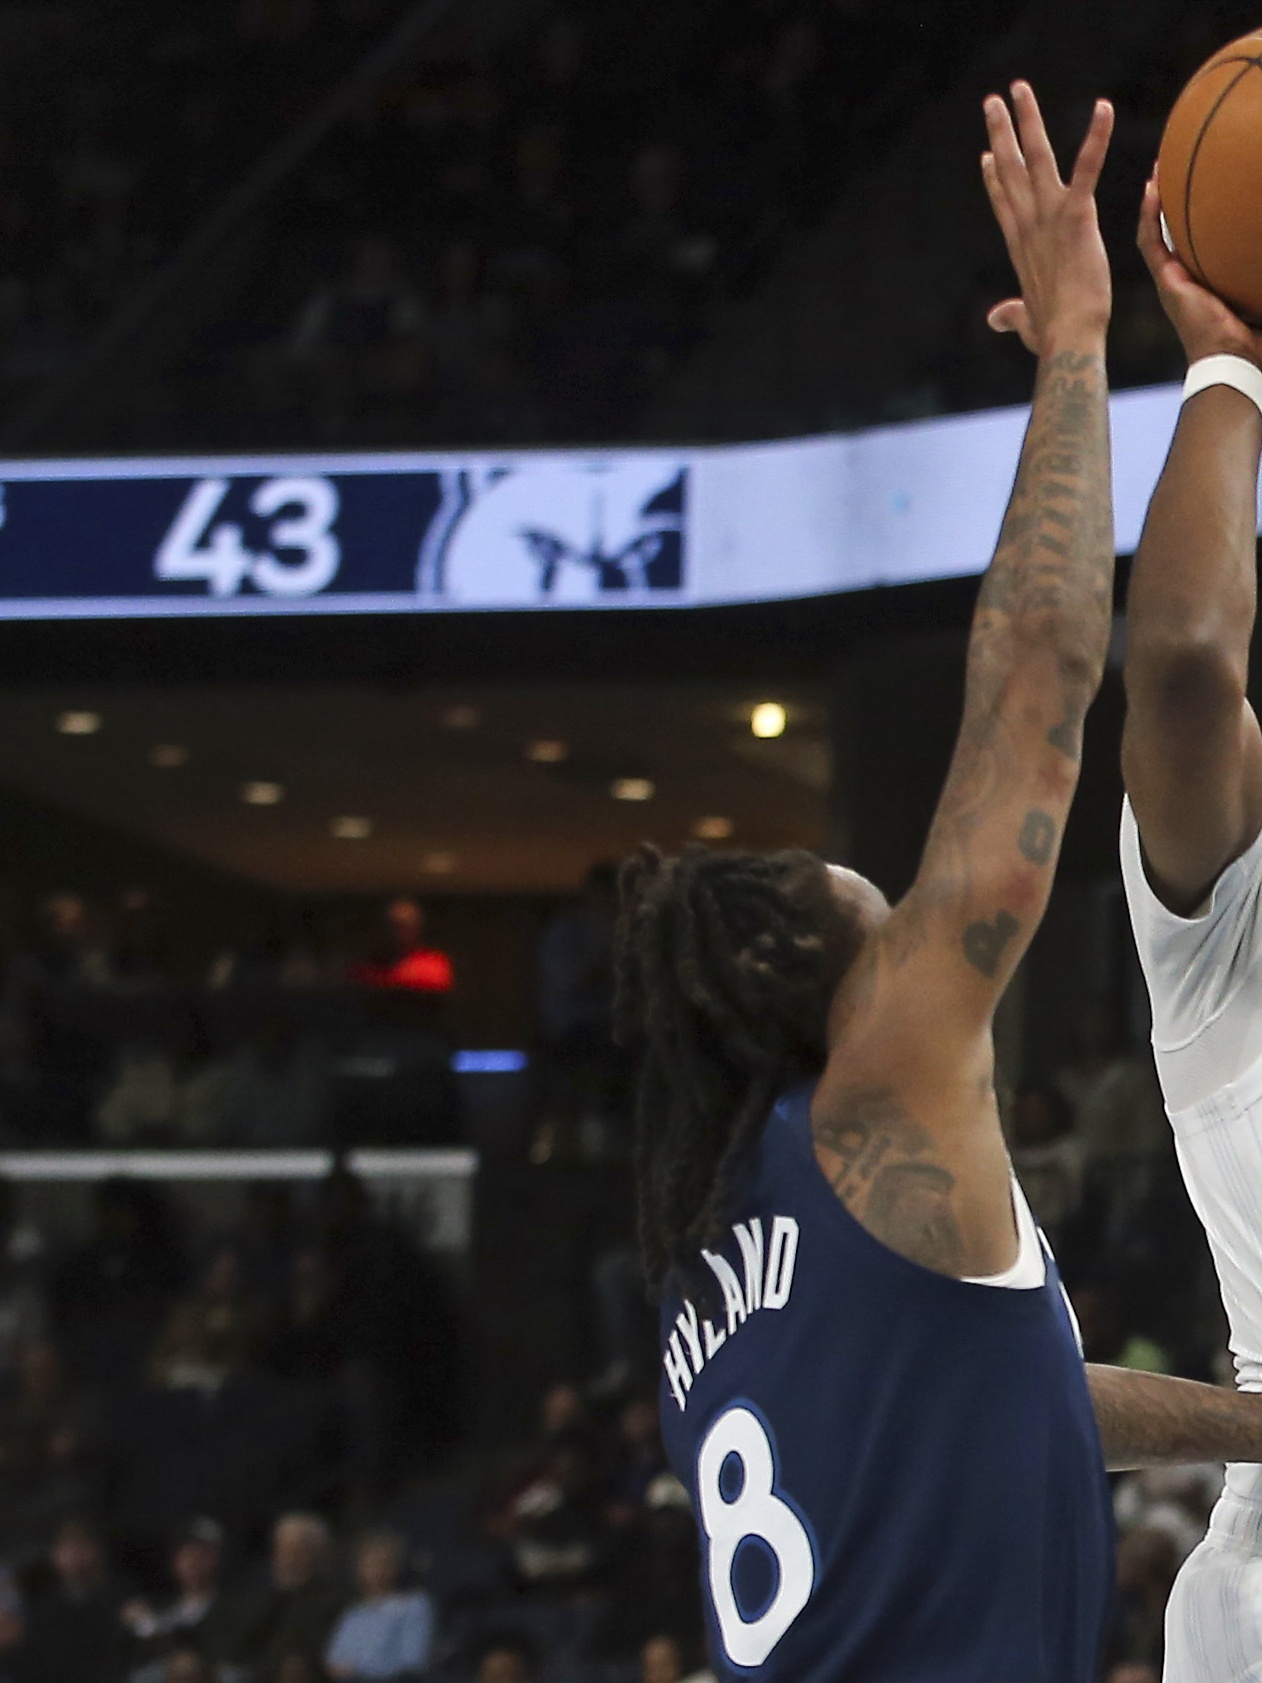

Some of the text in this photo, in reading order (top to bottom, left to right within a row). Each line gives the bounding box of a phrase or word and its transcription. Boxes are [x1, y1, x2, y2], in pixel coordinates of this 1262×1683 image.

[153, 476, 341, 598] 43
[664, 1216, 799, 1412] HYLAND
[699, 1404, 817, 1668] 8
